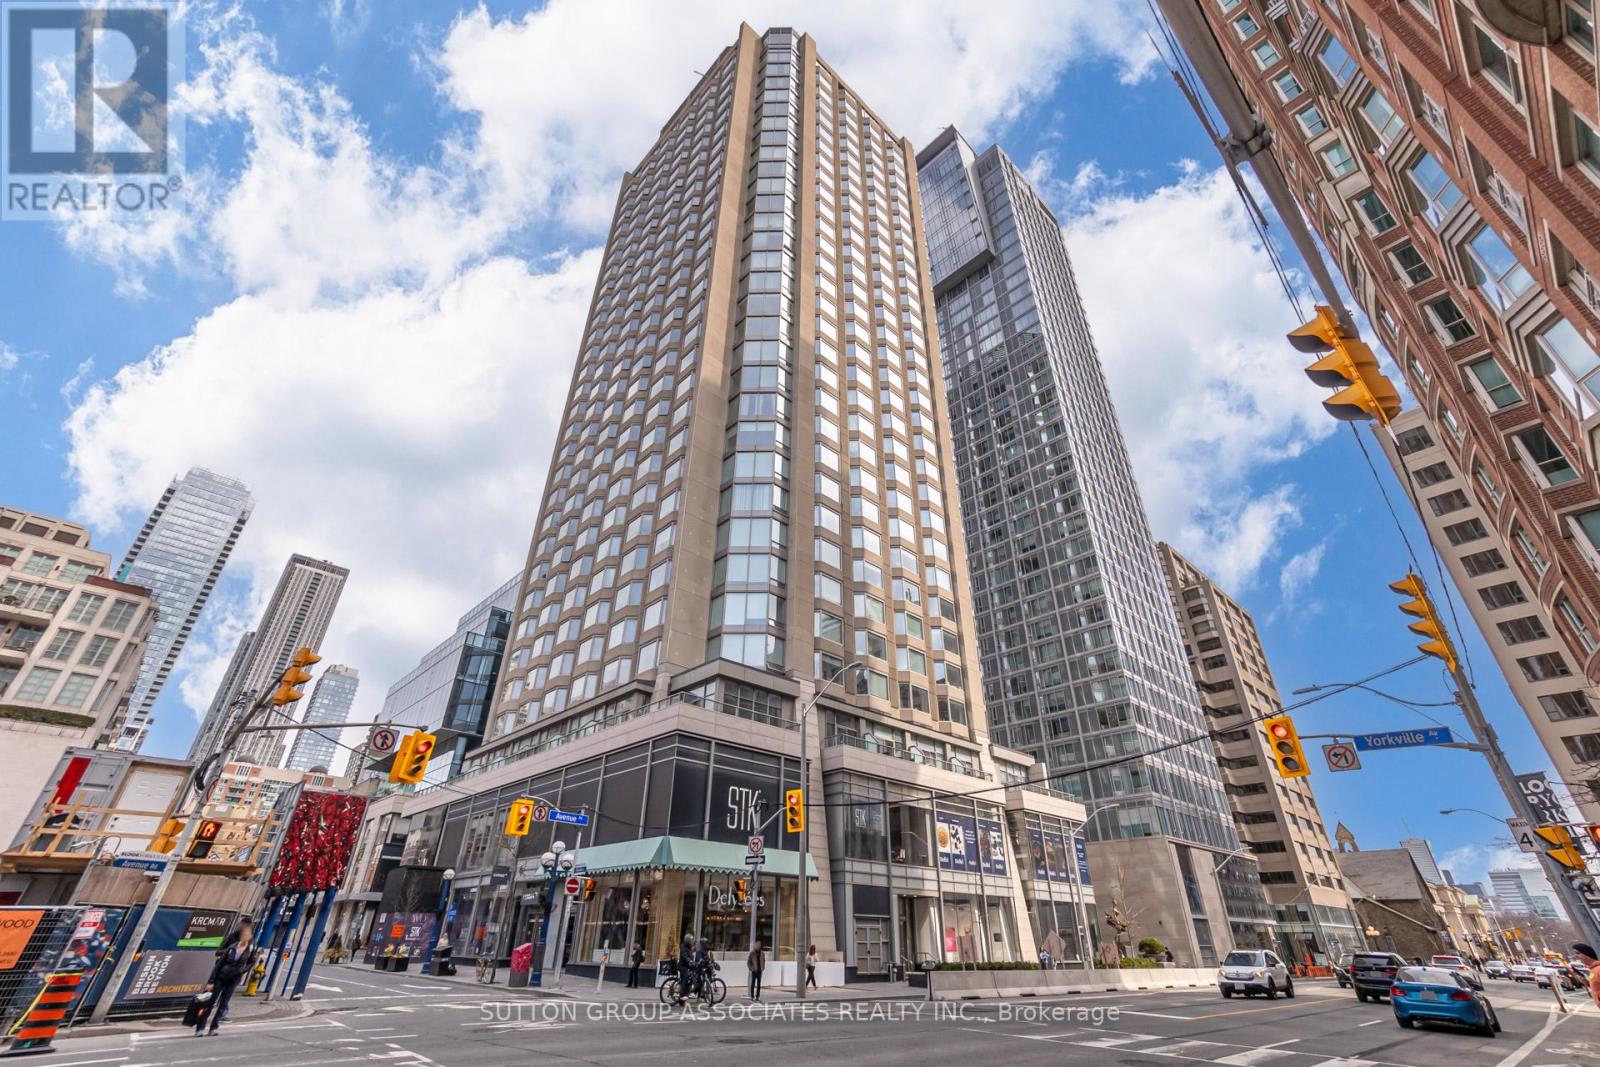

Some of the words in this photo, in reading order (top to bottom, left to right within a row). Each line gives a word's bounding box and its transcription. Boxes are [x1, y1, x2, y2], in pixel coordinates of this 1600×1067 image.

[1364, 732, 1424, 747] Yorkville
[555, 813, 577, 822] Avenue
[727, 786, 759, 831] STK
[121, 860, 149, 869] Avenue
[131, 955, 157, 994] BRISBIN
[140, 960, 162, 994] BROOK
[148, 955, 173, 994] BEYNON
